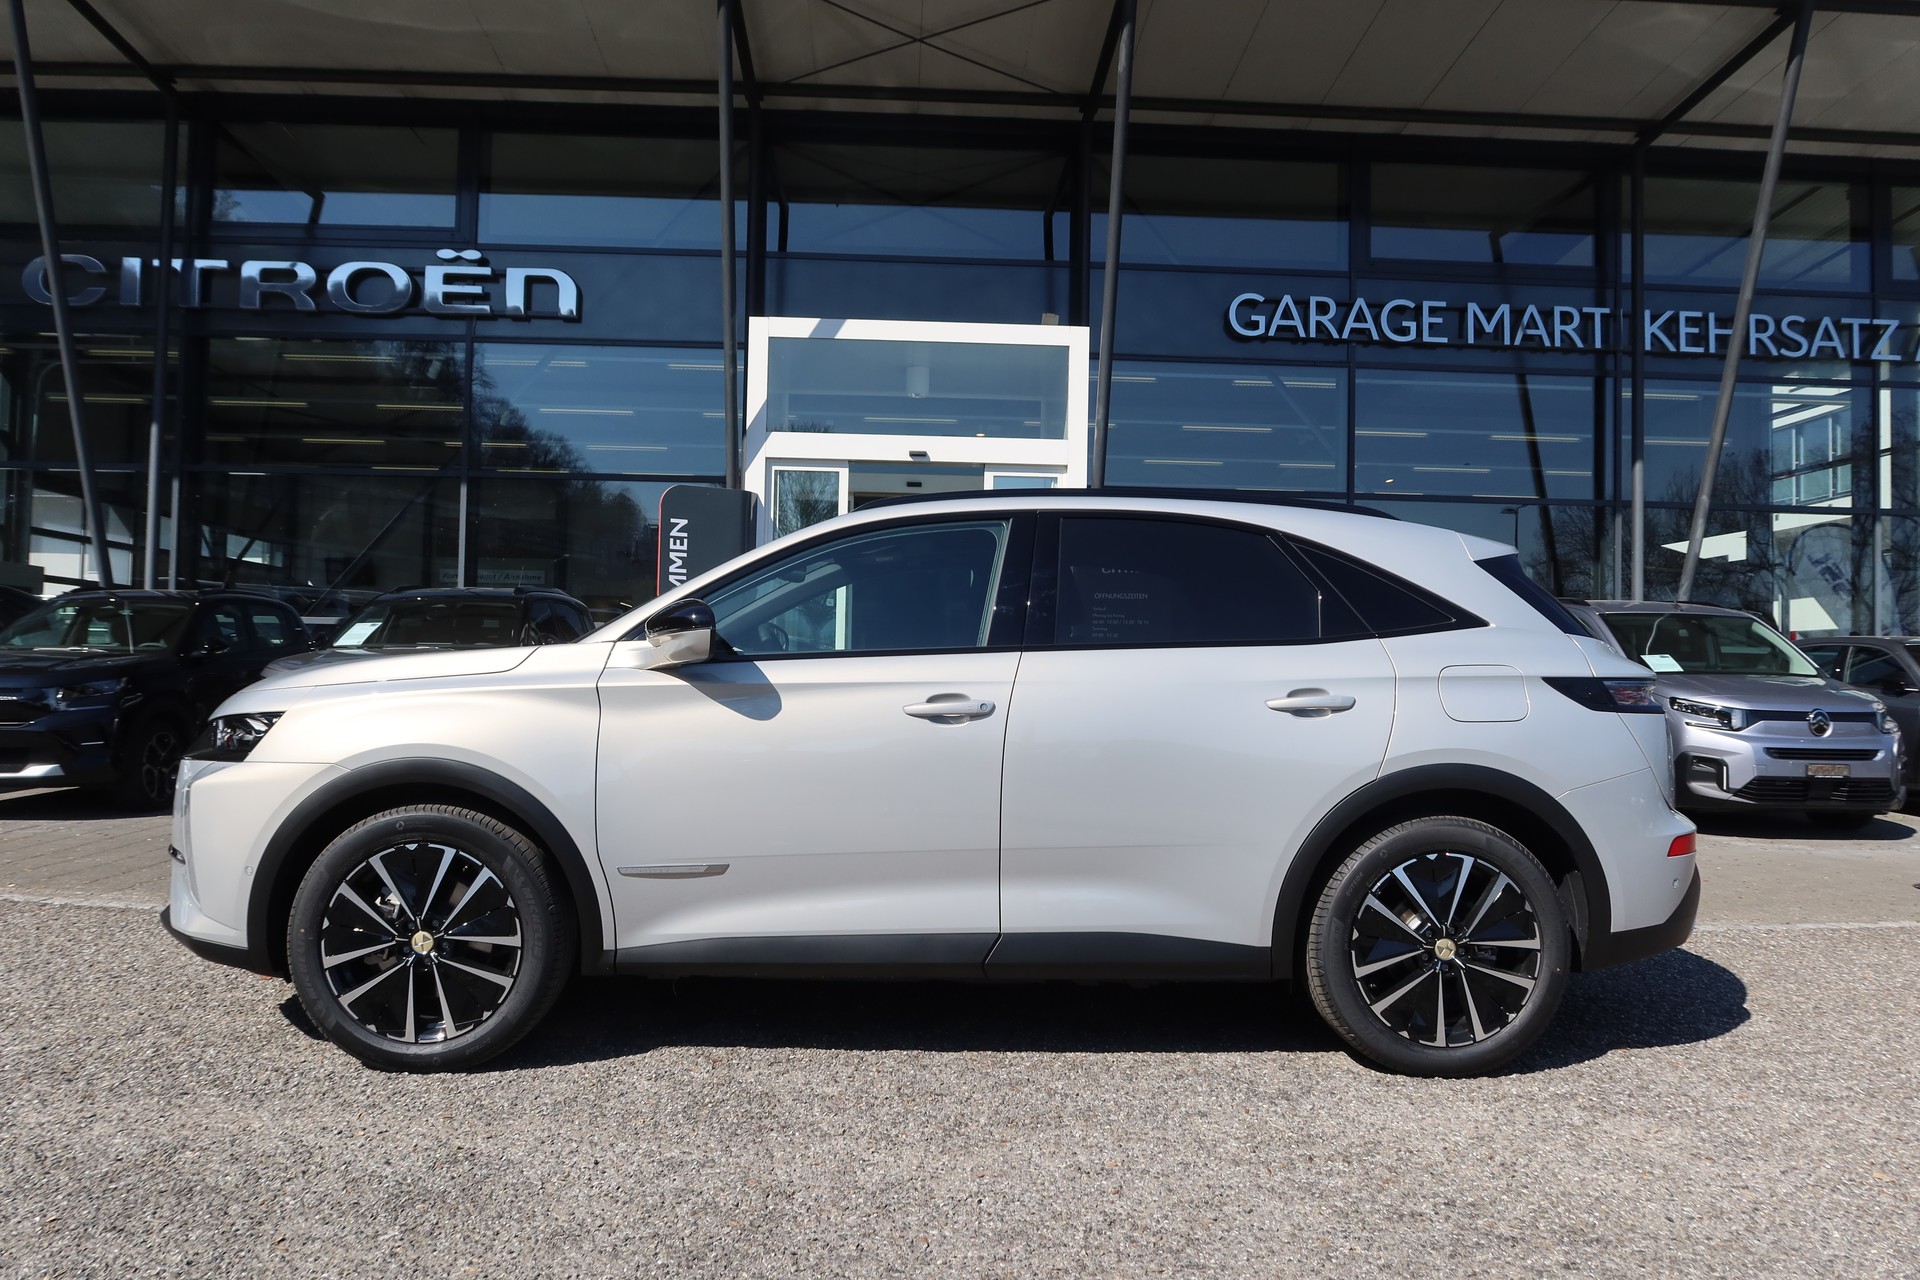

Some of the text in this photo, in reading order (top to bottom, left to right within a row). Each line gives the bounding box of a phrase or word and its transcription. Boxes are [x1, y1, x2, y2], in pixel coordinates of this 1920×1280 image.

[21, 248, 579, 318] CITROËN
[1228, 292, 1448, 344] GARAGE
[1467, 302, 1623, 349] MART
[1644, 309, 1902, 361] KEHRSATZ
